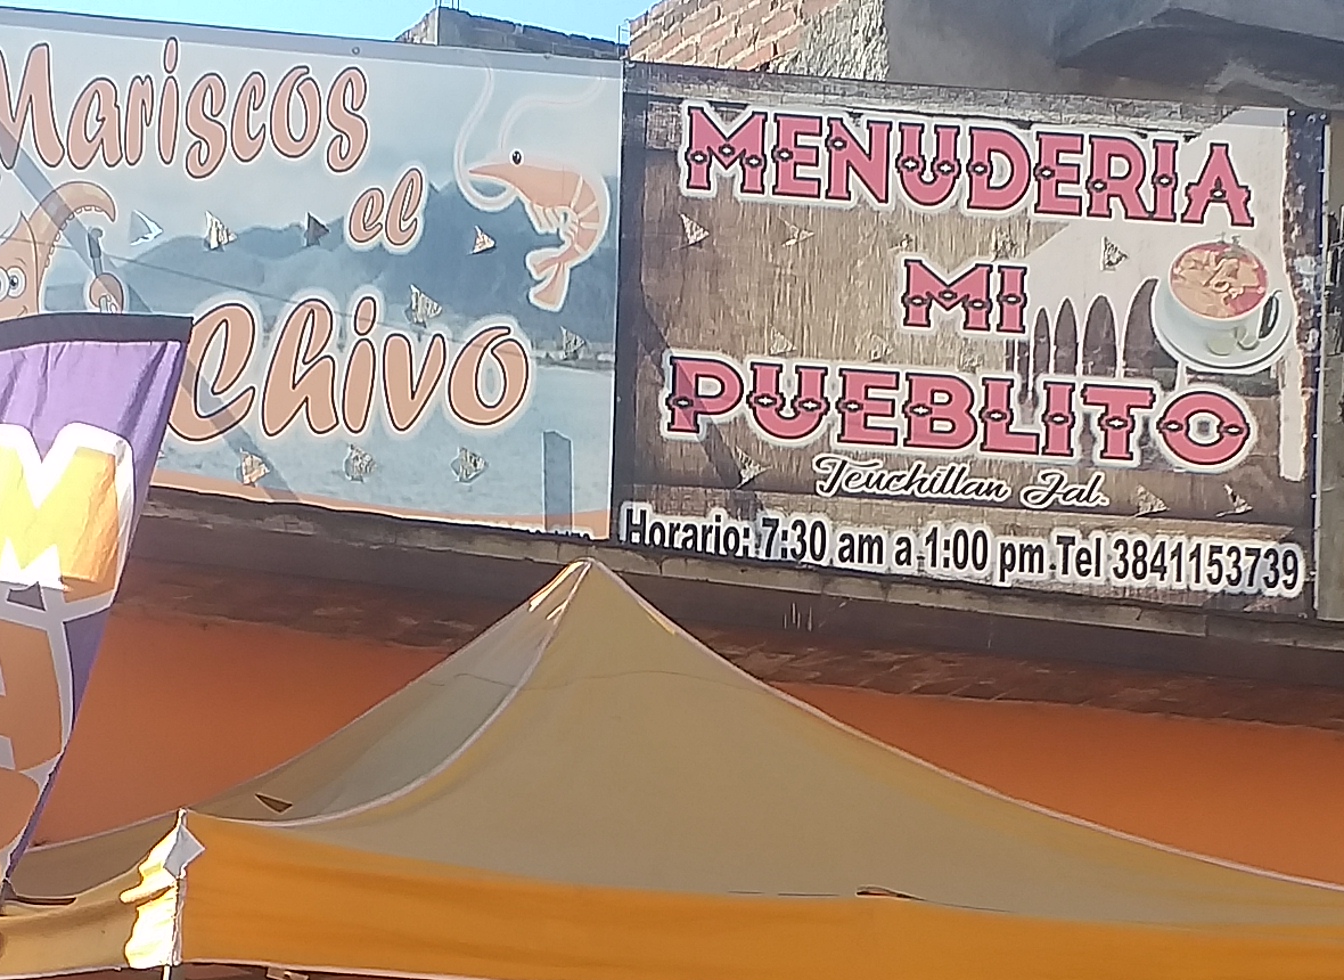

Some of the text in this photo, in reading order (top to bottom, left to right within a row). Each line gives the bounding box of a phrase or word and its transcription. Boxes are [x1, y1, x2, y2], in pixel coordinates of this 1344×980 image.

[684, 105, 1256, 228] MENUDERIA
[348, 168, 424, 247] el
[900, 258, 1027, 334] MI
[168, 295, 530, 442] Chivo
[666, 354, 1253, 466] PUEBLITO
[1022, 470, 1109, 508] Jal.
[626, 509, 1300, 590] Horario: 7:30 am a 1:00 pm Tel 3841153739
